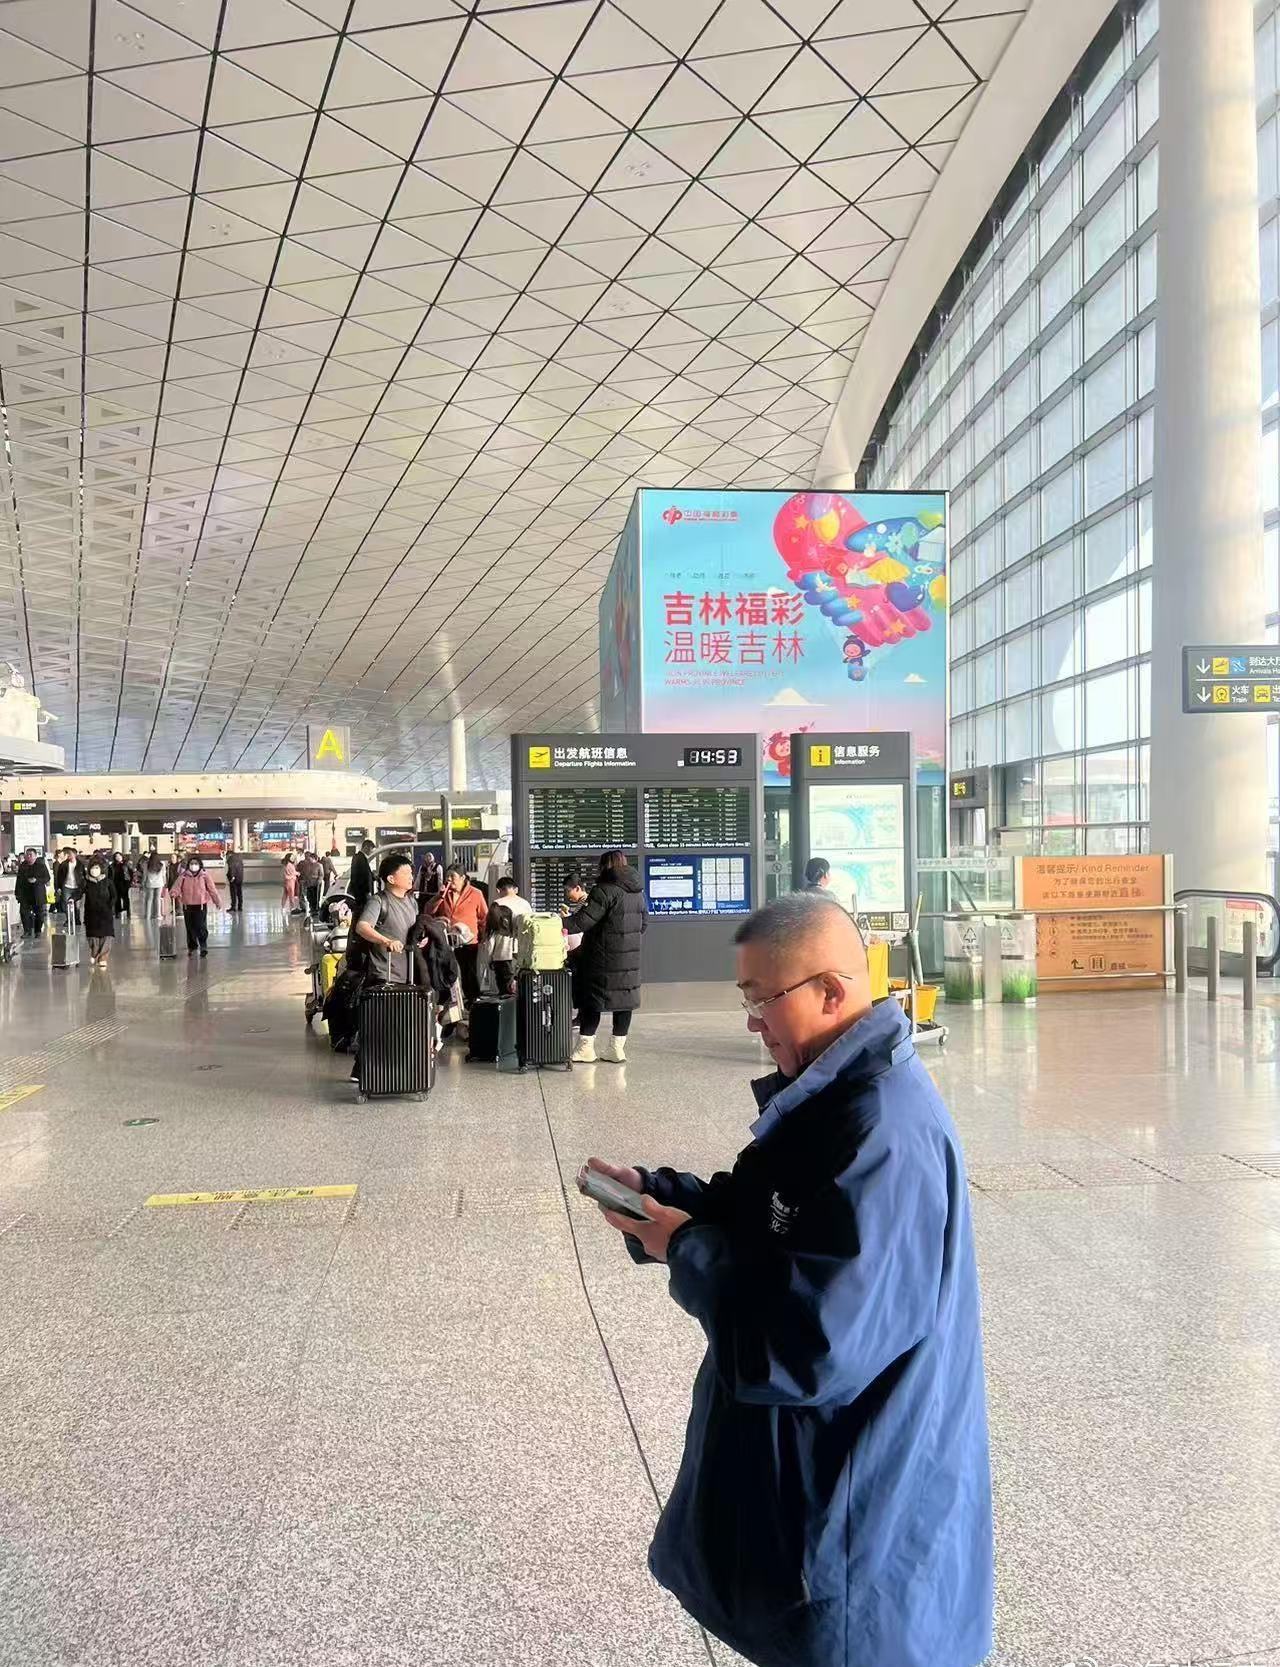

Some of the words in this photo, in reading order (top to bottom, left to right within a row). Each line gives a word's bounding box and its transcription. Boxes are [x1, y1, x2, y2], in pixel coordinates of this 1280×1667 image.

[663, 591, 804, 626] 吉林福彩
[664, 630, 806, 664] 温暖吉林
[1232, 685, 1249, 694] 火车
[315, 729, 344, 762] A
[834, 746, 880, 757] 信息服务
[554, 747, 628, 759] 出发航班信息
[692, 750, 738, 764] 14:53
[554, 760, 583, 768] Departure
[584, 760, 602, 768] Flights
[1081, 863, 1103, 873] Kind
[1104, 863, 1149, 872] Reminder
